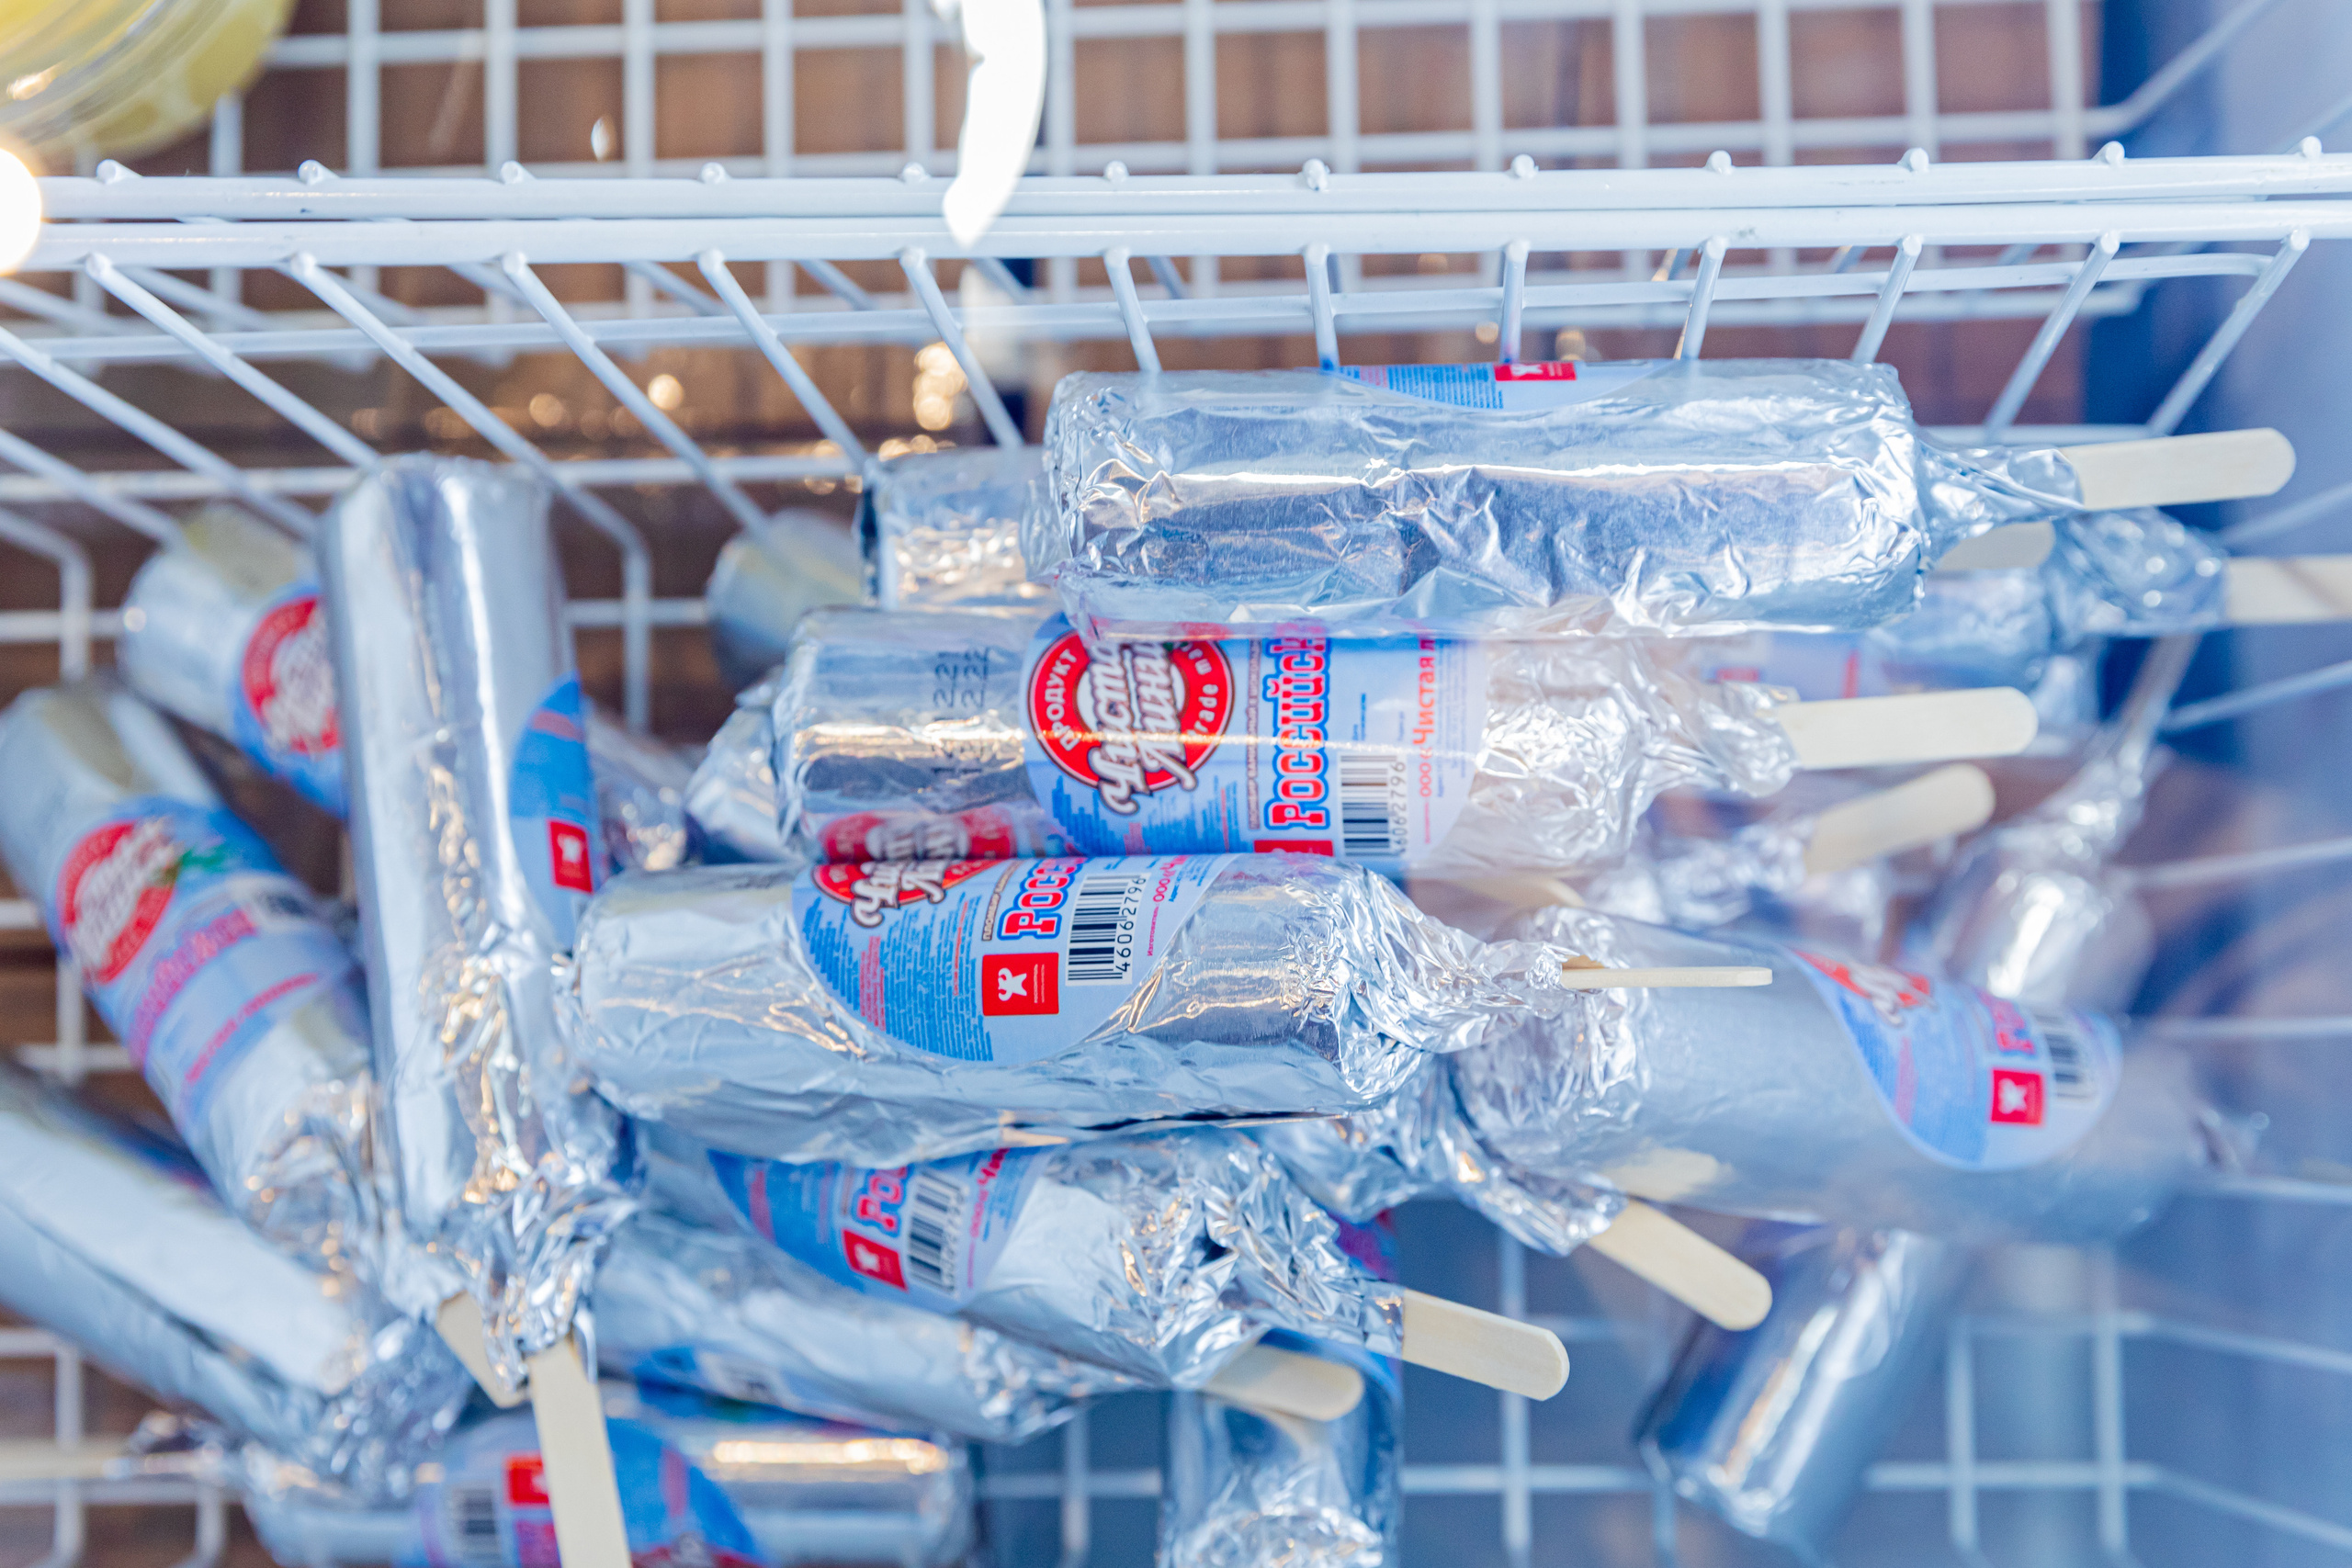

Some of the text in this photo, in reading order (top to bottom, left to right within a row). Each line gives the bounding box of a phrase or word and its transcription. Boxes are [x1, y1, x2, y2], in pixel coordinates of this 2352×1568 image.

[1045, 648, 1080, 751] ПРОДУКТ
[1086, 641, 1150, 816] Чиста
[1419, 762, 1432, 798] ООО
[1115, 876, 1148, 973] 46062796
[1152, 877, 1170, 903] ООО
